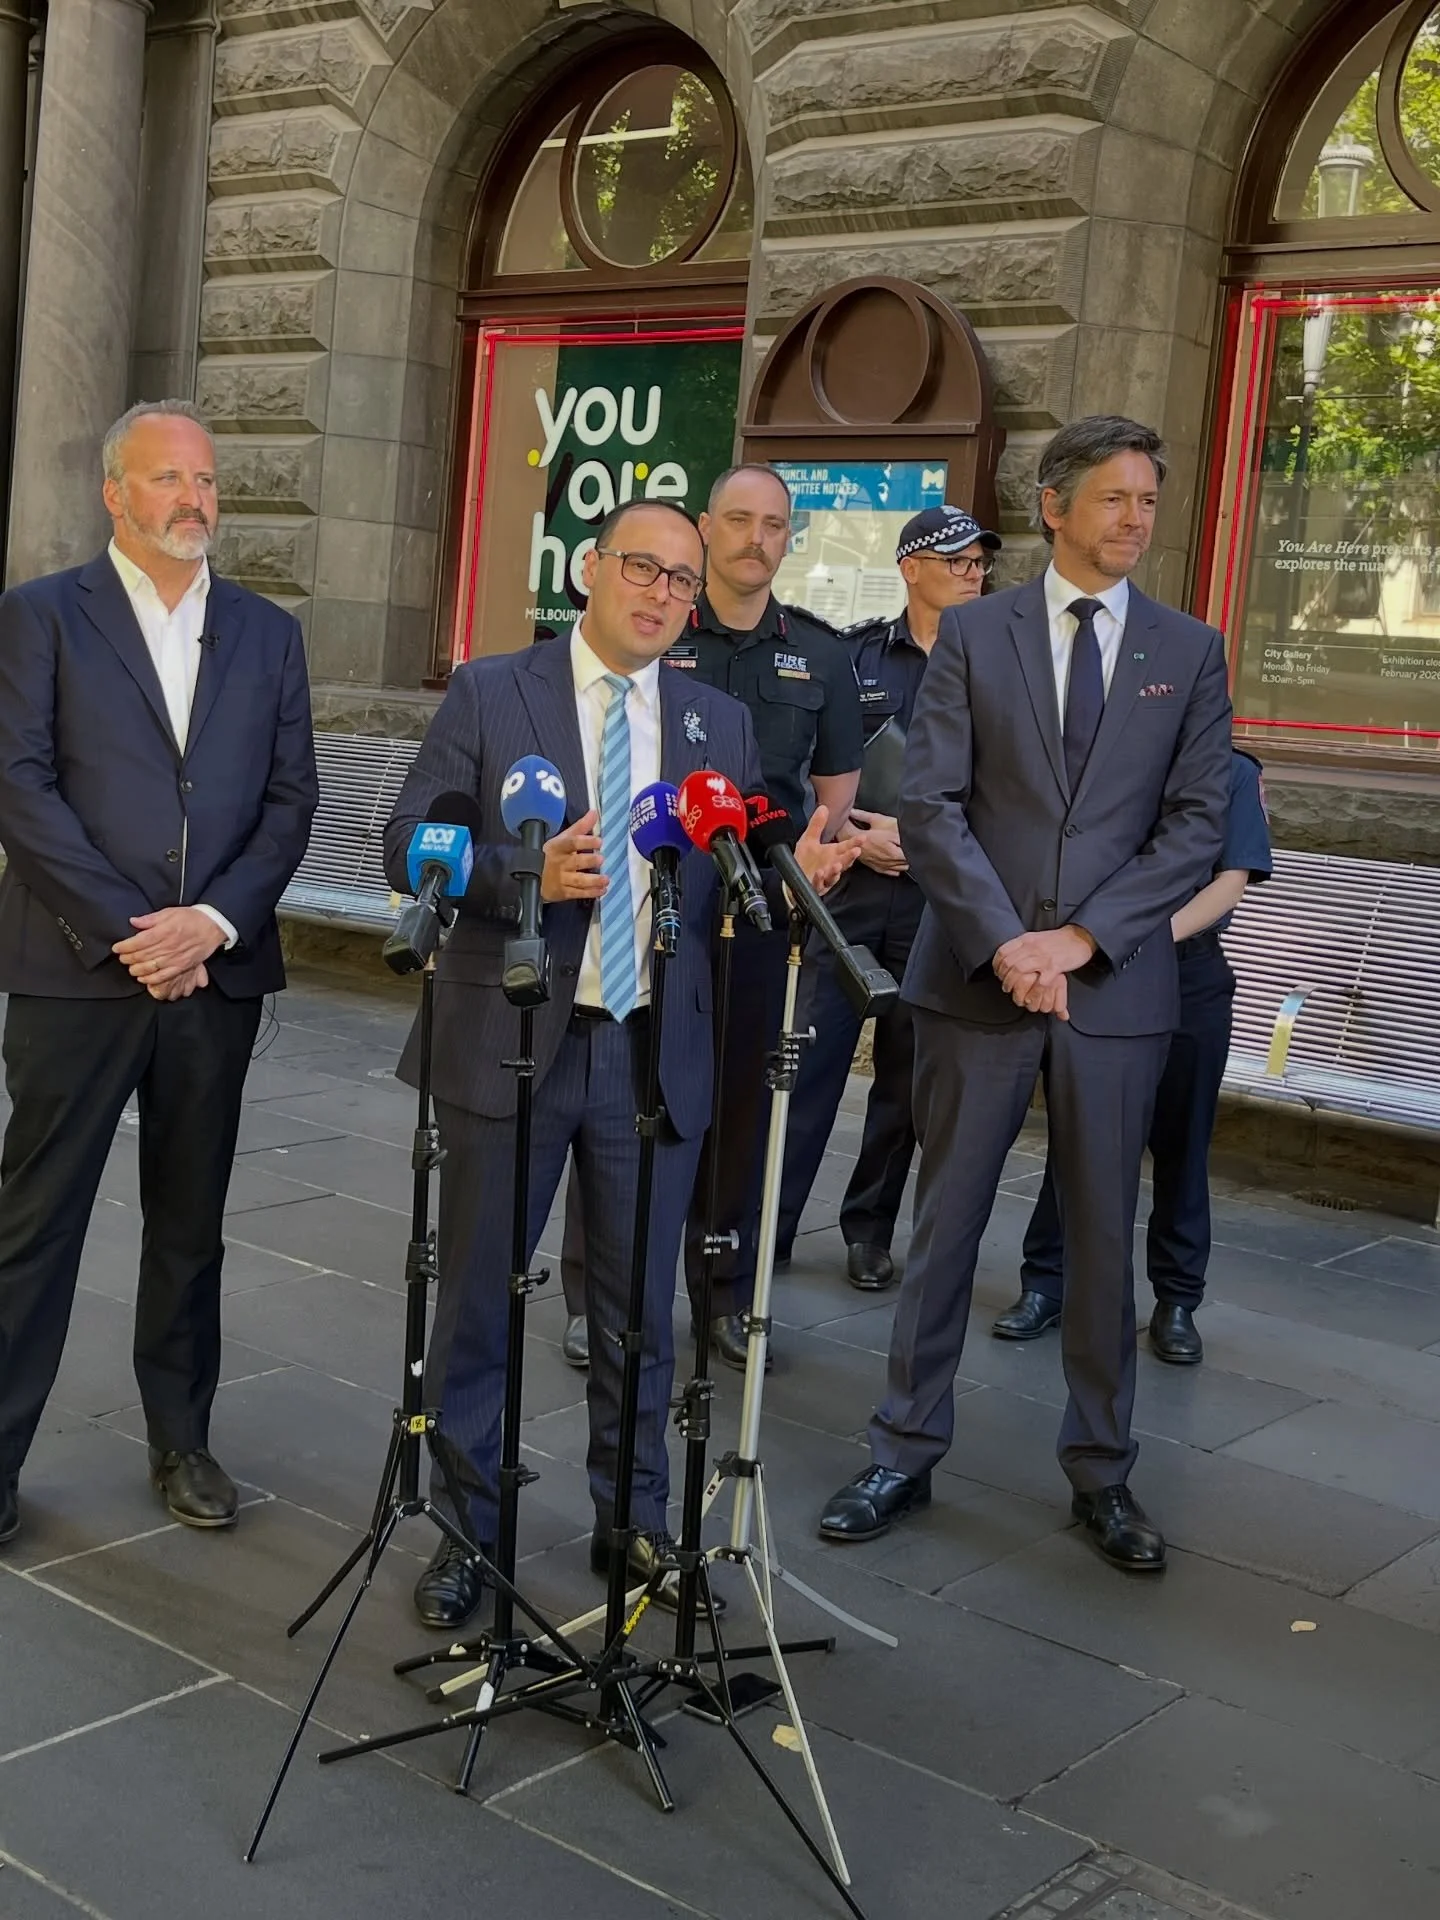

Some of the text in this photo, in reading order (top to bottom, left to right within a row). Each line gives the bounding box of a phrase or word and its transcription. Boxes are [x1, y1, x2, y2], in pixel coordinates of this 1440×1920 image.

[528, 385, 661, 468] you
[811, 469, 828, 481] AND
[822, 482, 859, 495] NOTICES
[1278, 540, 1305, 553] You
[1306, 541, 1333, 553] Are
[1334, 541, 1369, 554] Here
[1274, 557, 1332, 573] explores
[1333, 558, 1357, 571] the
[525, 607, 580, 622] MELBOUR
[774, 652, 807, 666] FIRE
[1264, 649, 1312, 661] City Gallery
[1382, 655, 1424, 665] Exhibition
[1263, 661, 1330, 675] Monday to Friday
[1381, 668, 1418, 680] February
[712, 795, 741, 811] SBS
[630, 809, 658, 835] NEWS
[685, 804, 703, 834] SBS
[749, 809, 787, 829] NEWS
[419, 843, 451, 853] NEWS
